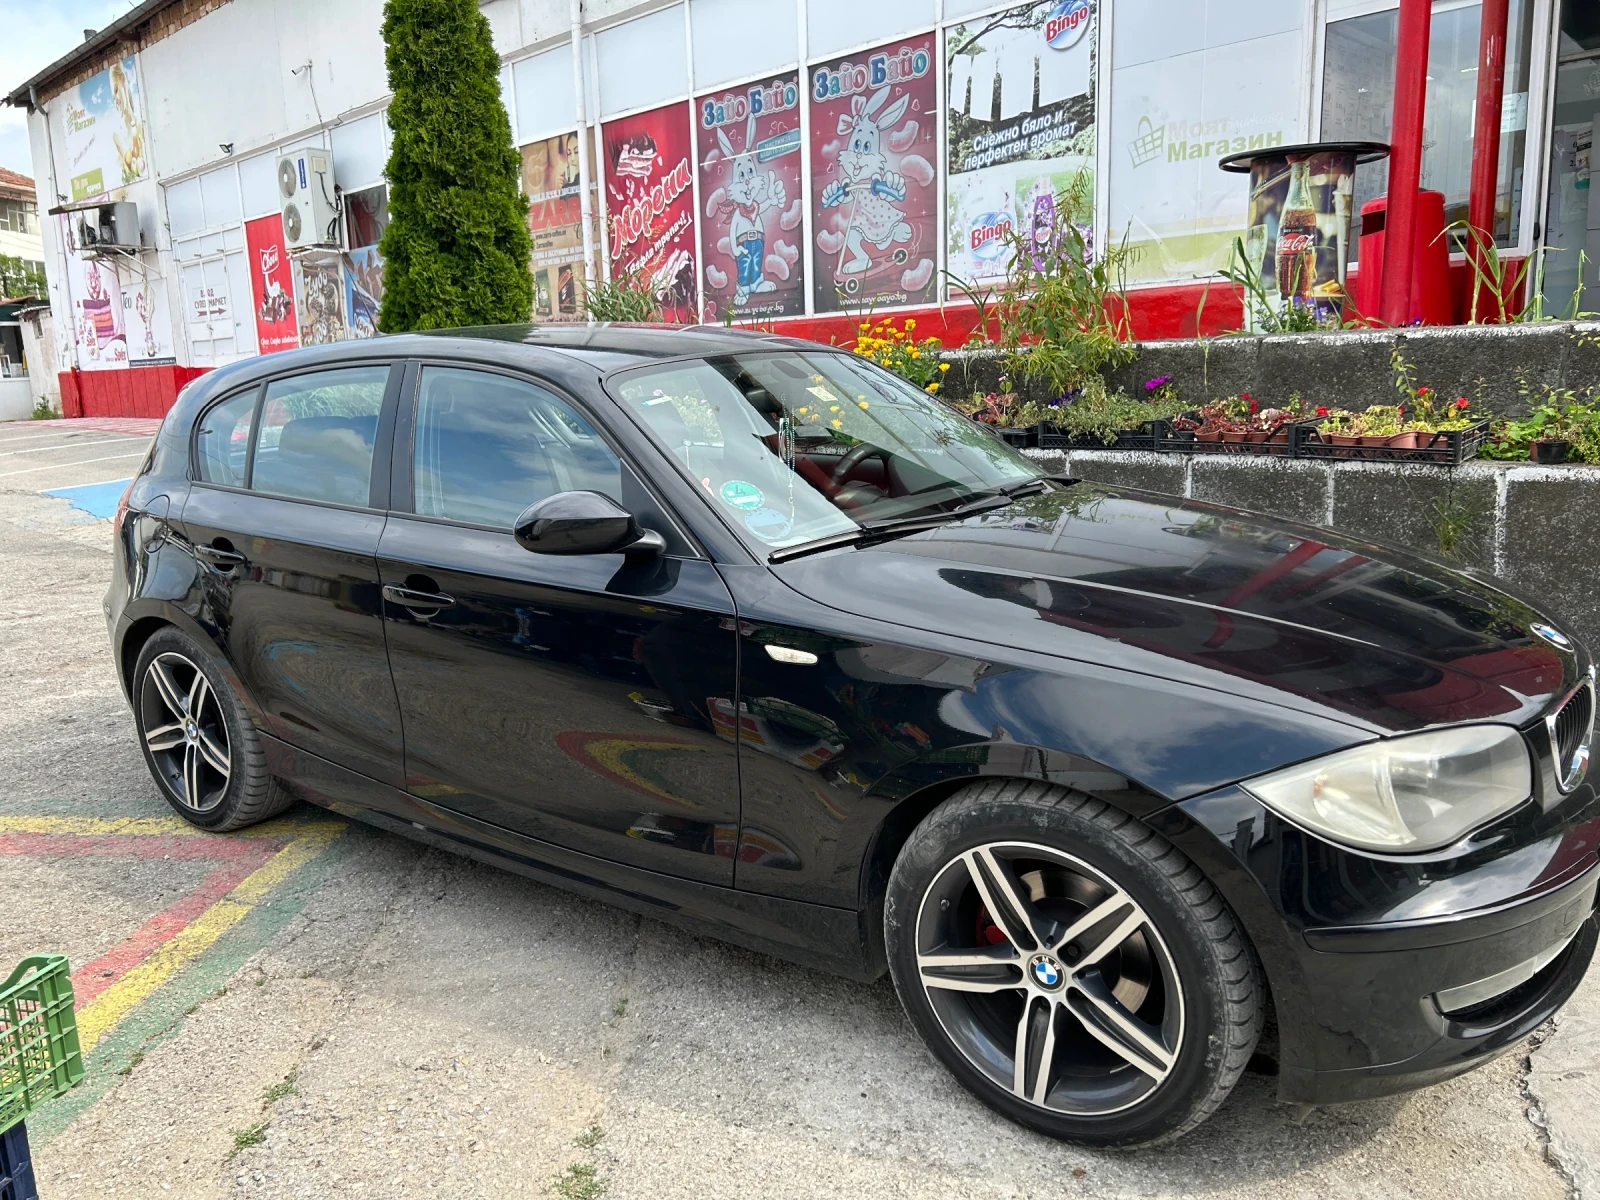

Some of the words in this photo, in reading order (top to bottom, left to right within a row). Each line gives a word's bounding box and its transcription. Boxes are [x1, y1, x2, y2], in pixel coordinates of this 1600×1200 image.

[1046, 7, 1088, 42] Bingo
[814, 64, 867, 100] Зайо
[870, 48, 928, 87] Байо
[703, 95, 747, 127] Зайо
[749, 82, 797, 115] Байо
[964, 138, 1028, 170] перфектен
[1030, 121, 1077, 149] аромат
[973, 125, 1019, 151] Снежно
[1021, 113, 1051, 135] бяло
[1053, 110, 1064, 122] и
[1168, 117, 1228, 141] Моят
[1167, 131, 1282, 163] Магазин
[612, 158, 692, 259] Морени
[653, 210, 687, 251] трепач!
[971, 220, 1011, 249] Bingo
[195, 297, 226, 309] СУПЕМАРКЕТ
[200, 288, 214, 297] ВОД
[1032, 956, 1061, 970] BMW
